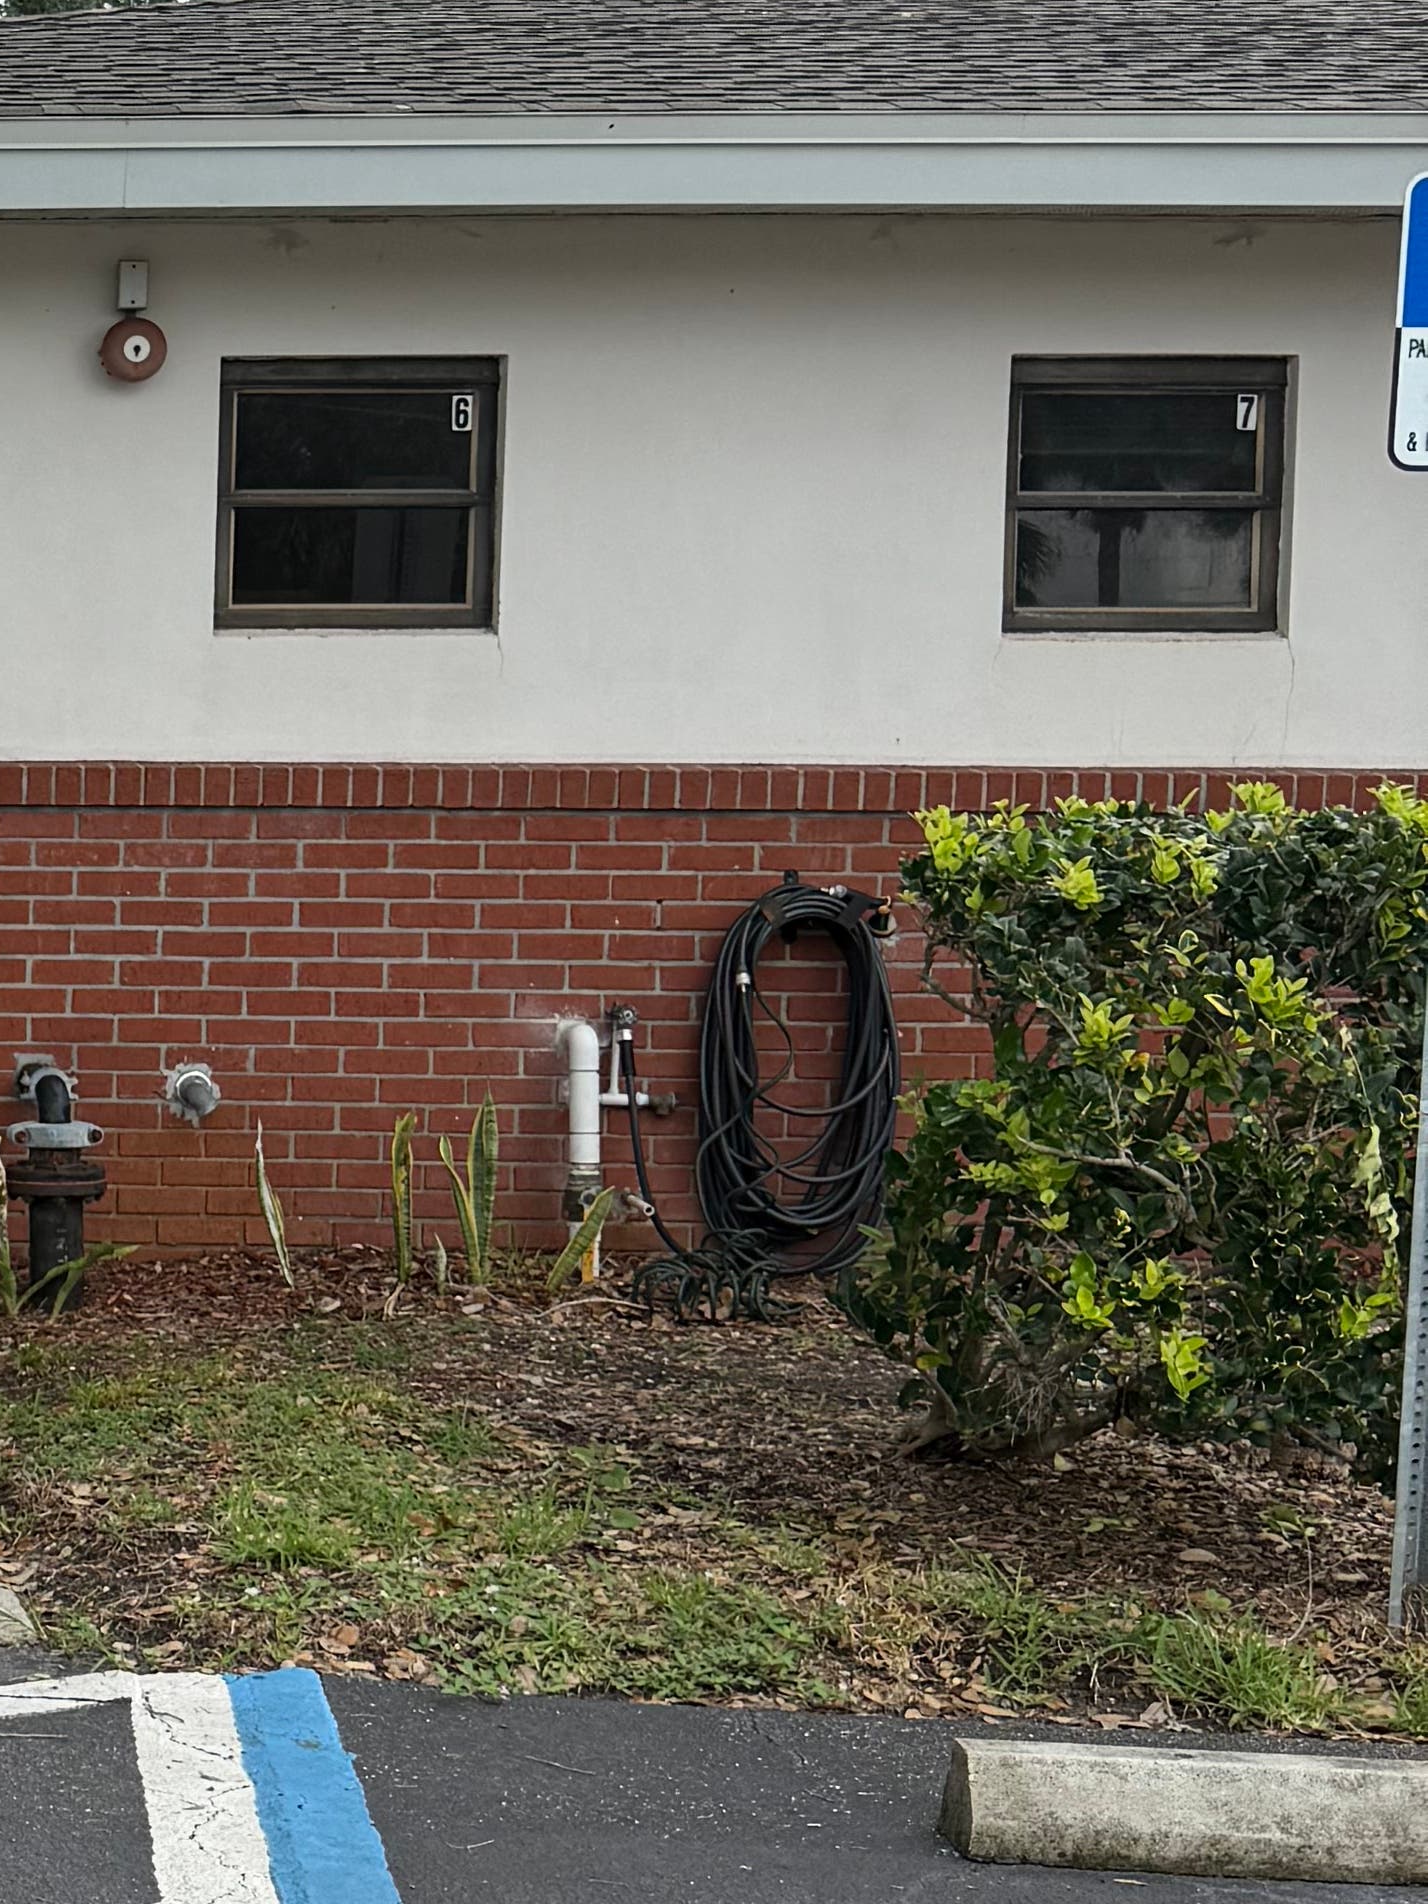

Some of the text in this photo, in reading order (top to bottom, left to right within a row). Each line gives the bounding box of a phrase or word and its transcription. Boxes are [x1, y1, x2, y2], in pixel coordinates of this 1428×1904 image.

[1408, 338, 1428, 358] PA
[455, 397, 469, 428] 6
[1240, 396, 1255, 428] 7
[1406, 431, 1417, 452] &
